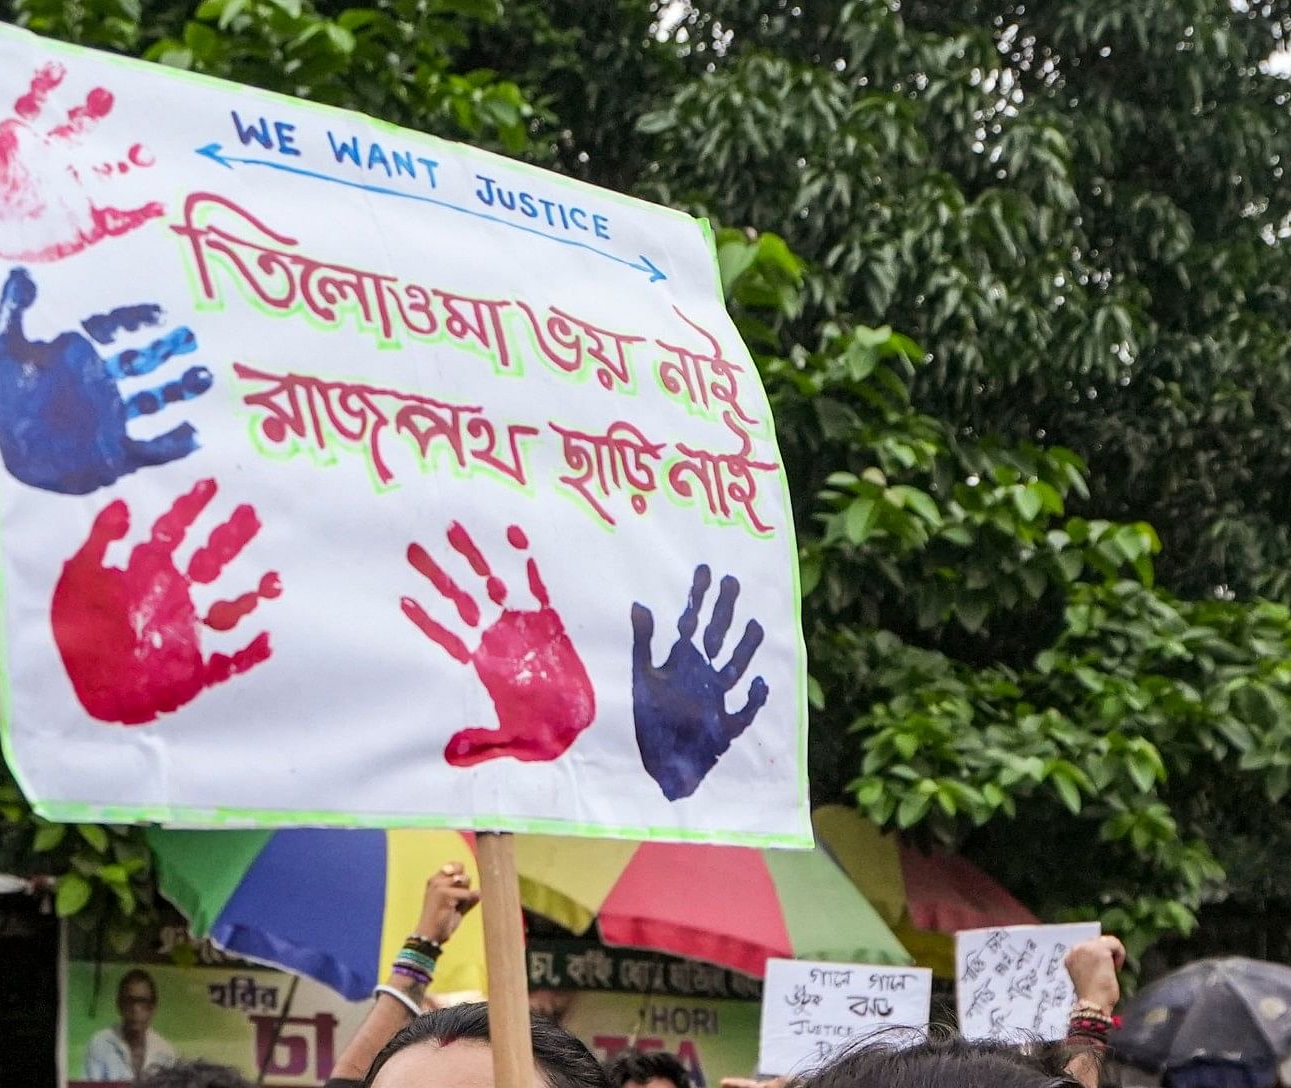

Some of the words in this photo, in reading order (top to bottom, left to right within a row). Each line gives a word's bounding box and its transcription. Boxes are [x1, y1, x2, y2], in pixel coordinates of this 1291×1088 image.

[231, 109, 301, 157] WE
[326, 130, 439, 189] WANT
[475, 174, 611, 240] JUSTICE
[516, 300, 646, 391] ভয়
[655, 304, 759, 425] নাই
[232, 362, 539, 486] রাজপথ
[667, 410, 780, 533] নাই
[248, 1012, 339, 1084] চা
